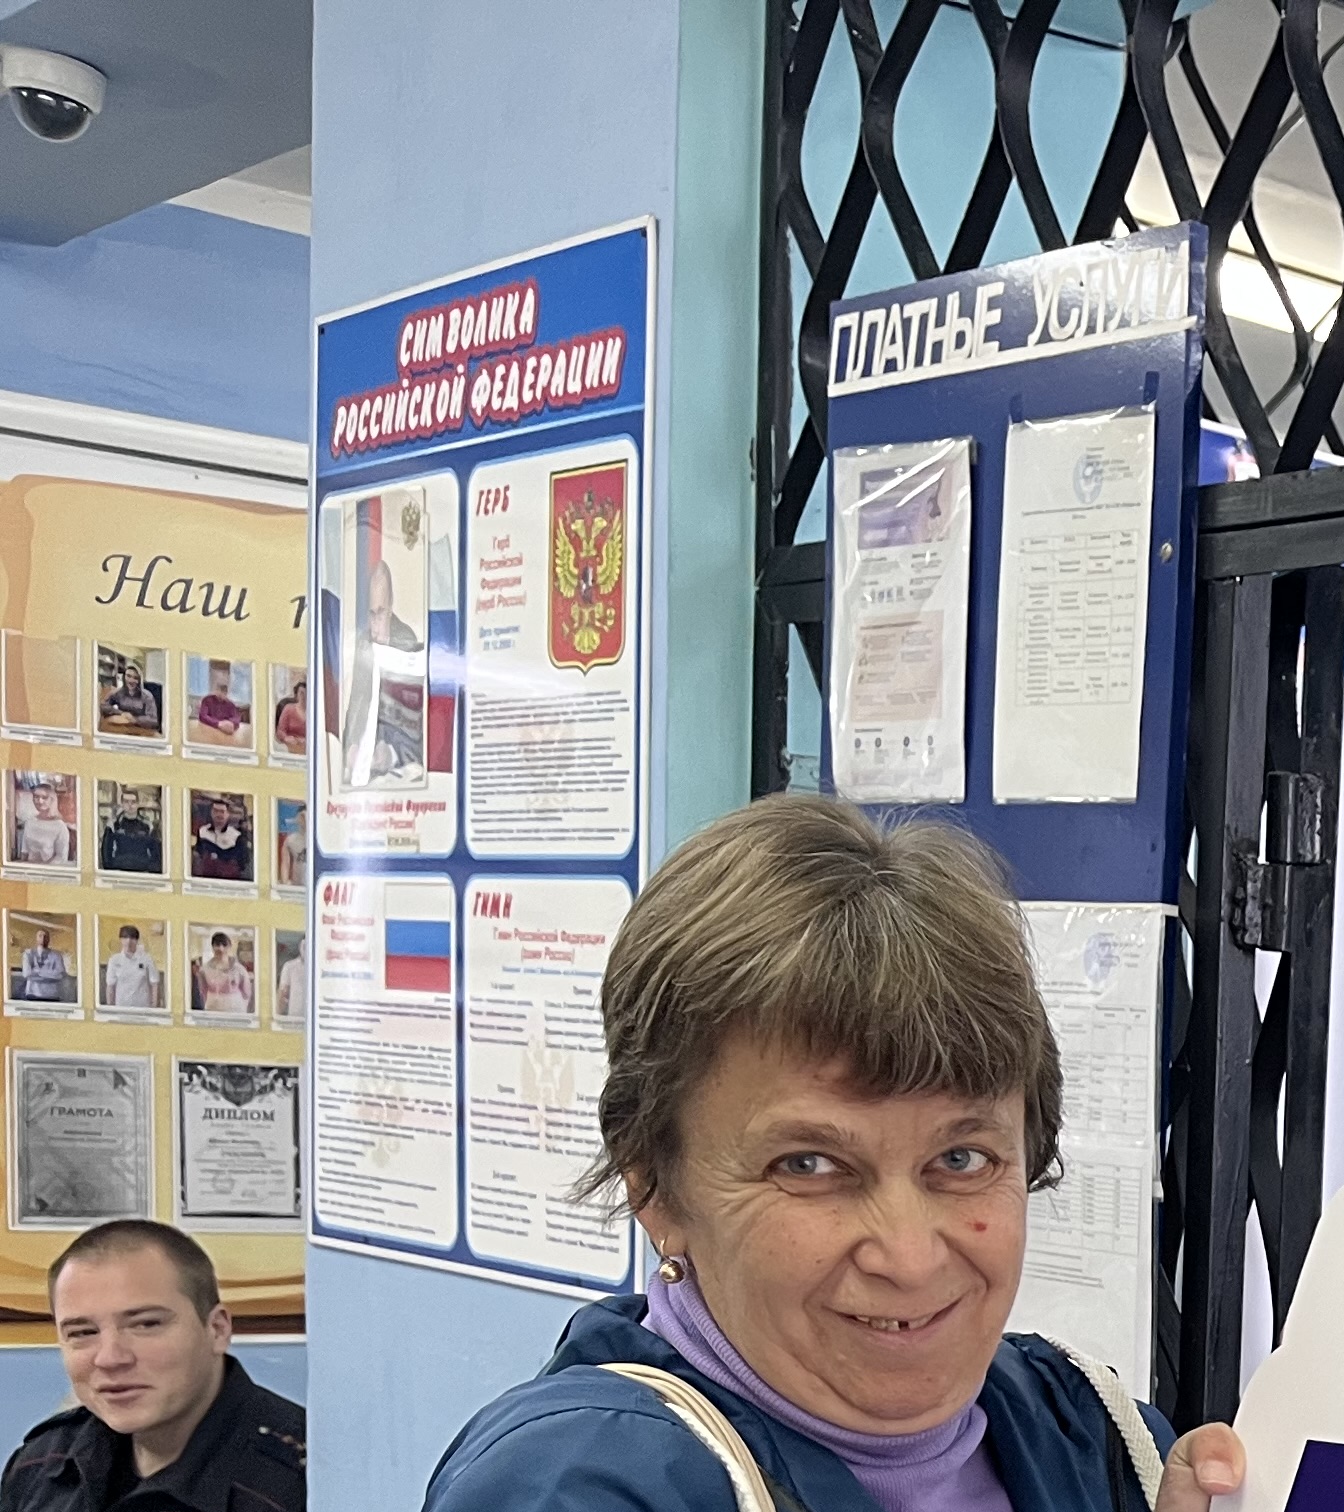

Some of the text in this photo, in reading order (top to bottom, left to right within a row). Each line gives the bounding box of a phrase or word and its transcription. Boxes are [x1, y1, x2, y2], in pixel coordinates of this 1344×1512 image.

[1028, 240, 1189, 346] УСЛУГИ
[400, 287, 535, 367] СИМВОЛИКА
[333, 336, 622, 448] РОССИЙСКОЙ ФЕДЕРАЦИИ
[476, 485, 510, 516] ГЕРБ
[95, 554, 250, 621] Наш
[473, 891, 513, 919] ГИМН
[49, 1106, 114, 1118] ГРАМОТА
[202, 1107, 275, 1121] ДИПЛОМ
